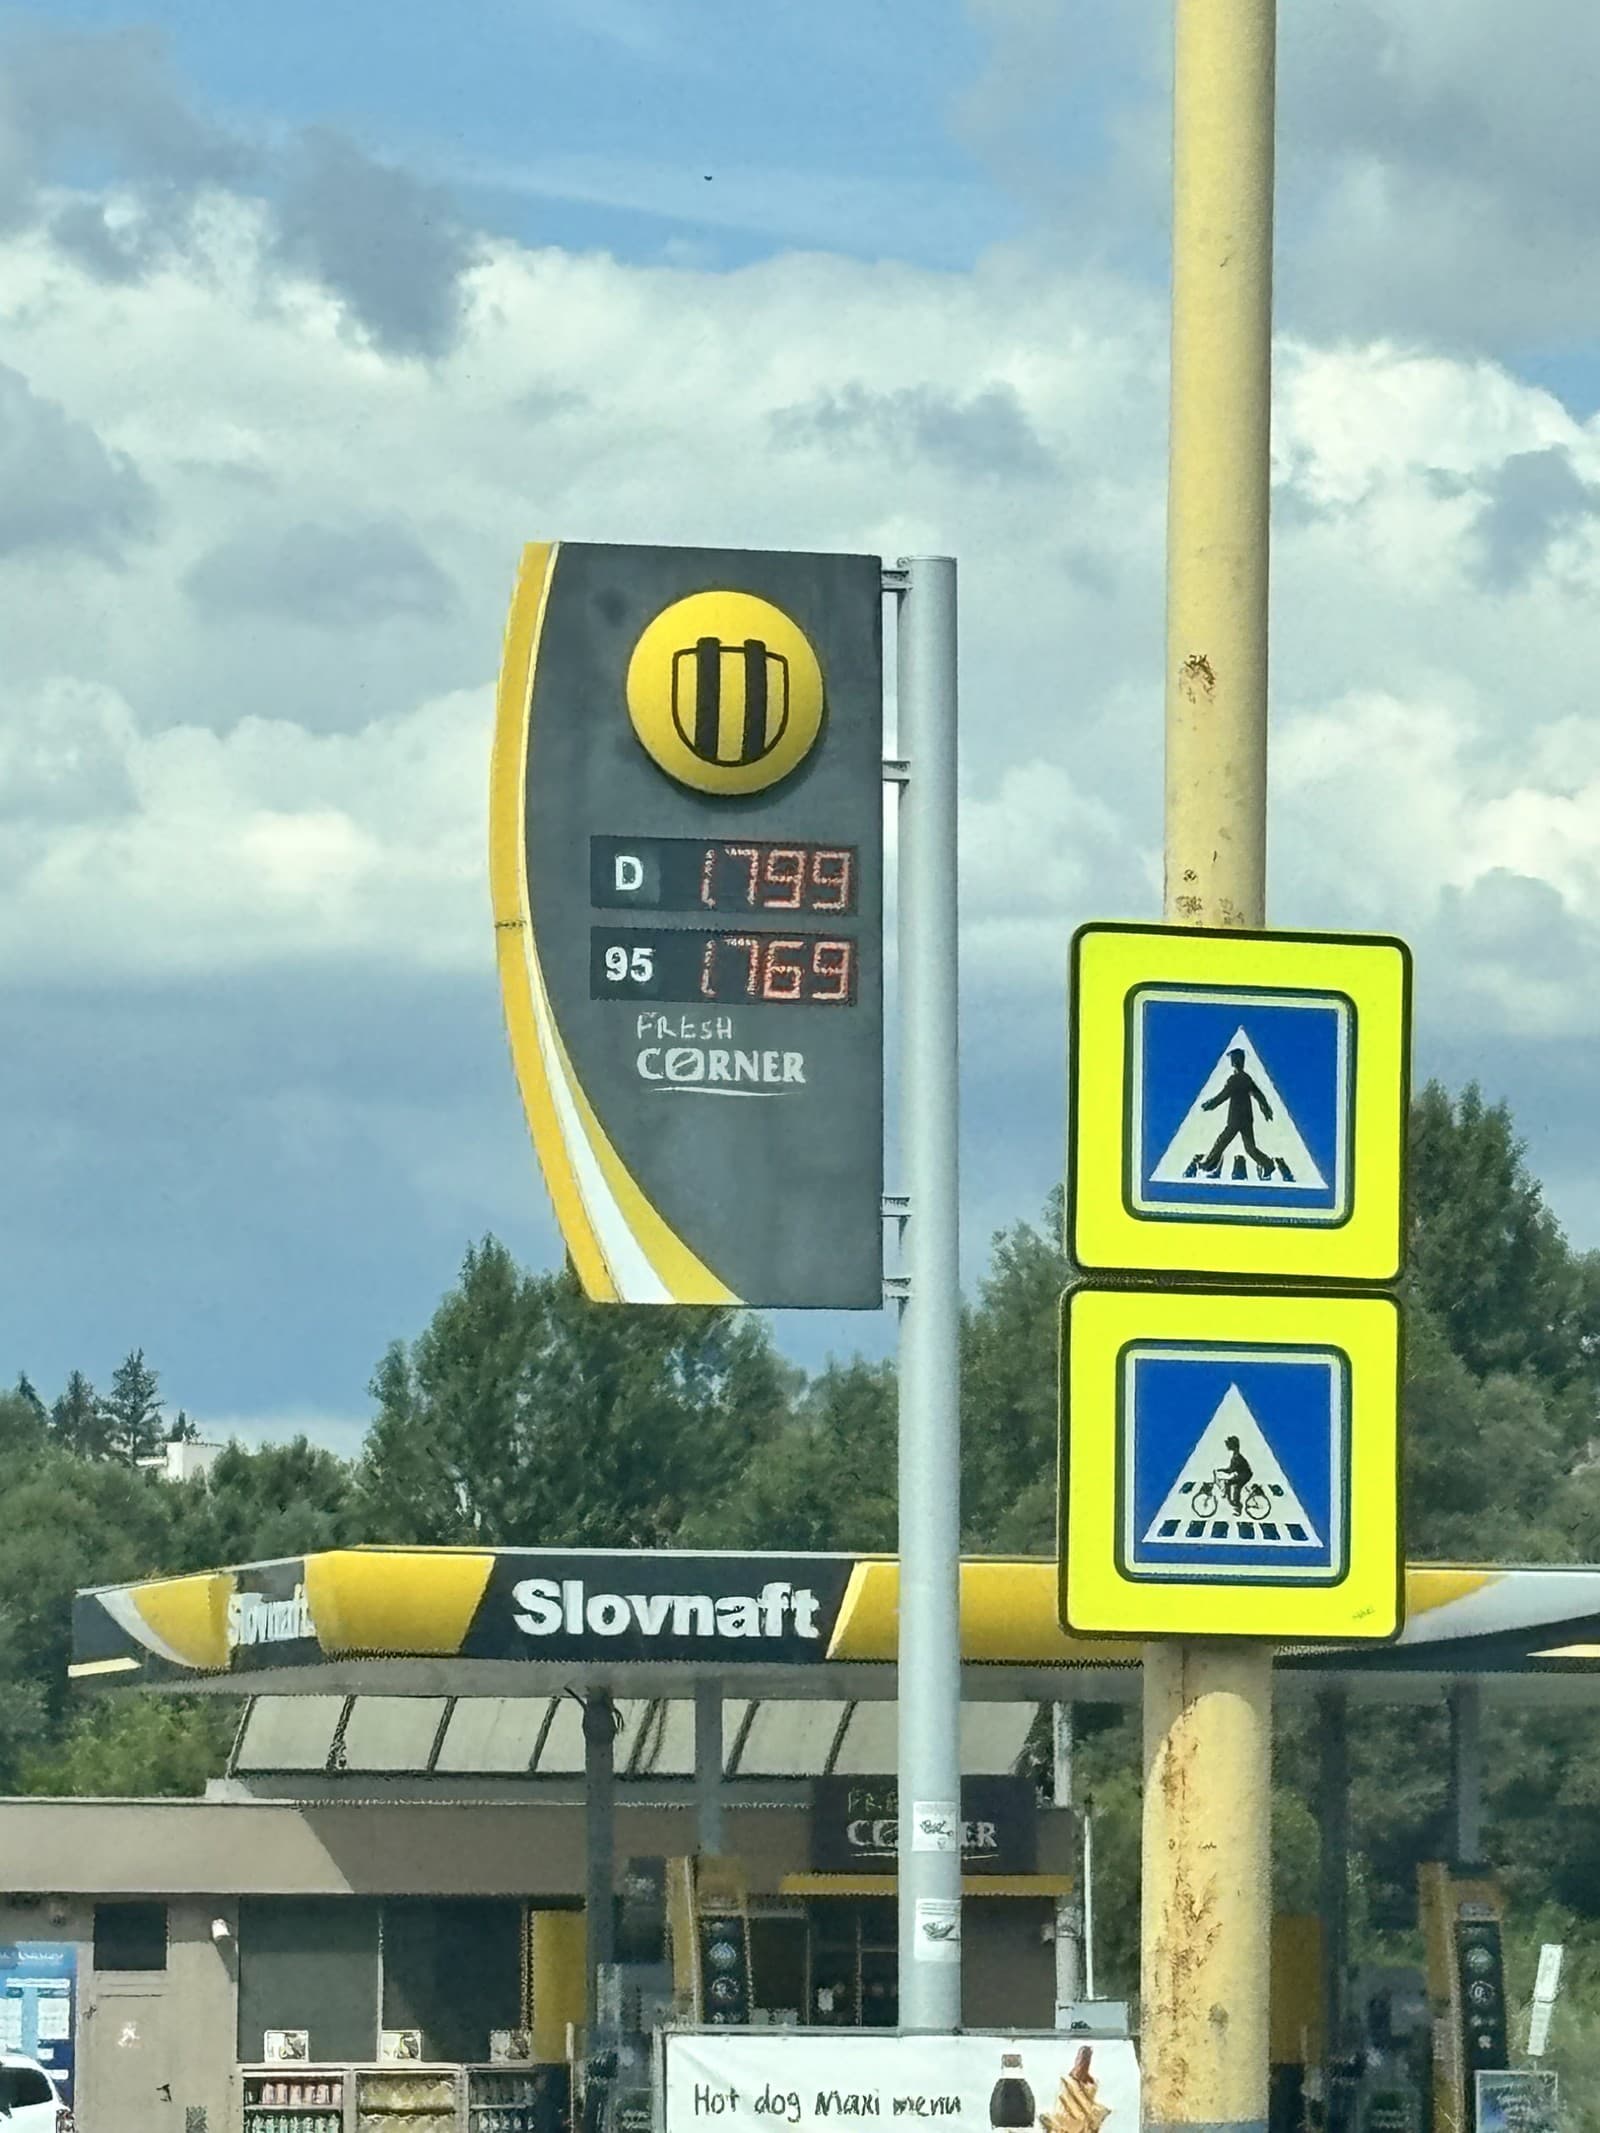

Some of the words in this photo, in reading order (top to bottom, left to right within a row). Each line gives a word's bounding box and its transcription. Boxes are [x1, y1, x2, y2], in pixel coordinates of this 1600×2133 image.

[614, 855, 644, 891] D
[604, 946, 654, 983] 95
[636, 1012, 733, 1040] FRESH
[513, 1578, 822, 1640] Slovnaft
[694, 2083, 739, 2116] Hot
[753, 2083, 802, 2123] dog
[814, 2089, 880, 2116] Maxi
[892, 2096, 962, 2117] menu
